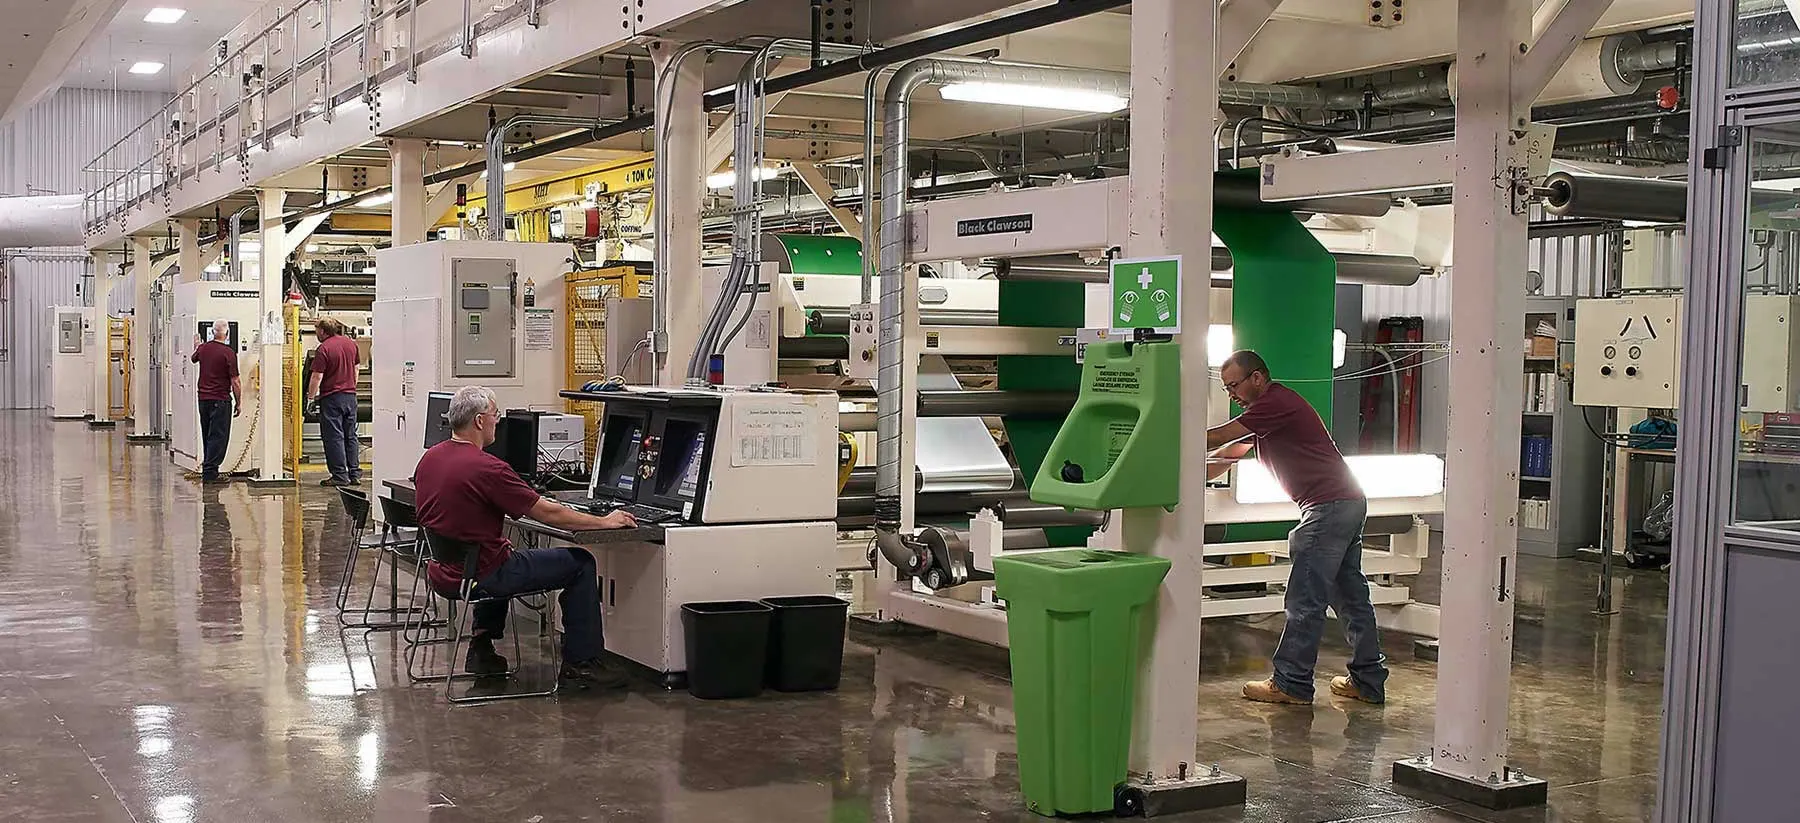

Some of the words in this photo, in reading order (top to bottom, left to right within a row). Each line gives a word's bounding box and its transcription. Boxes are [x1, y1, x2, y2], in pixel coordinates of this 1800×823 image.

[632, 168, 645, 183] TON
[959, 221, 985, 234] Black
[986, 219, 1031, 232] Clawson
